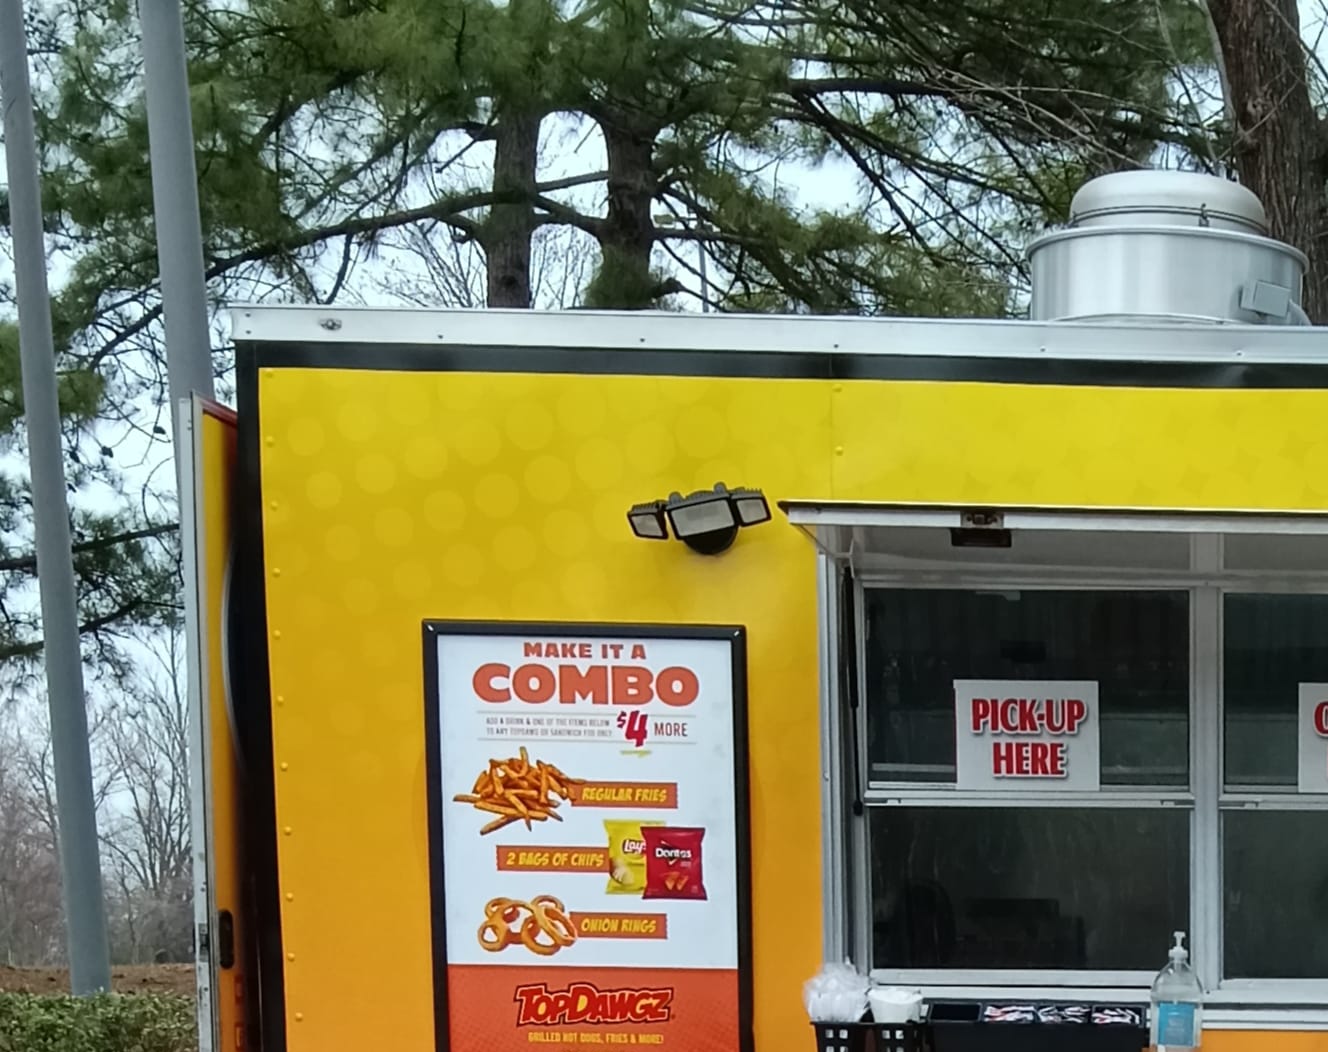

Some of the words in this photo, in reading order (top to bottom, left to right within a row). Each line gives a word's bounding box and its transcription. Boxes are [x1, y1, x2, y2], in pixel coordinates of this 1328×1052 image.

[524, 643, 593, 659] MAKE
[602, 644, 622, 659] IT
[631, 644, 647, 659] A
[472, 664, 699, 706] COMBO
[971, 699, 1086, 734] PICK-UP
[617, 711, 647, 747] $4
[655, 722, 688, 737] MORE
[992, 742, 1067, 777] HERE
[582, 788, 631, 801] REGULAR
[635, 789, 667, 803] FRIES
[506, 854, 515, 865] 2
[518, 853, 548, 865] BAGS
[551, 853, 569, 866] OF
[571, 853, 604, 867] CHIPS
[655, 847, 691, 860] Doritos
[582, 919, 618, 932] ONION
[621, 920, 656, 933] RINGS
